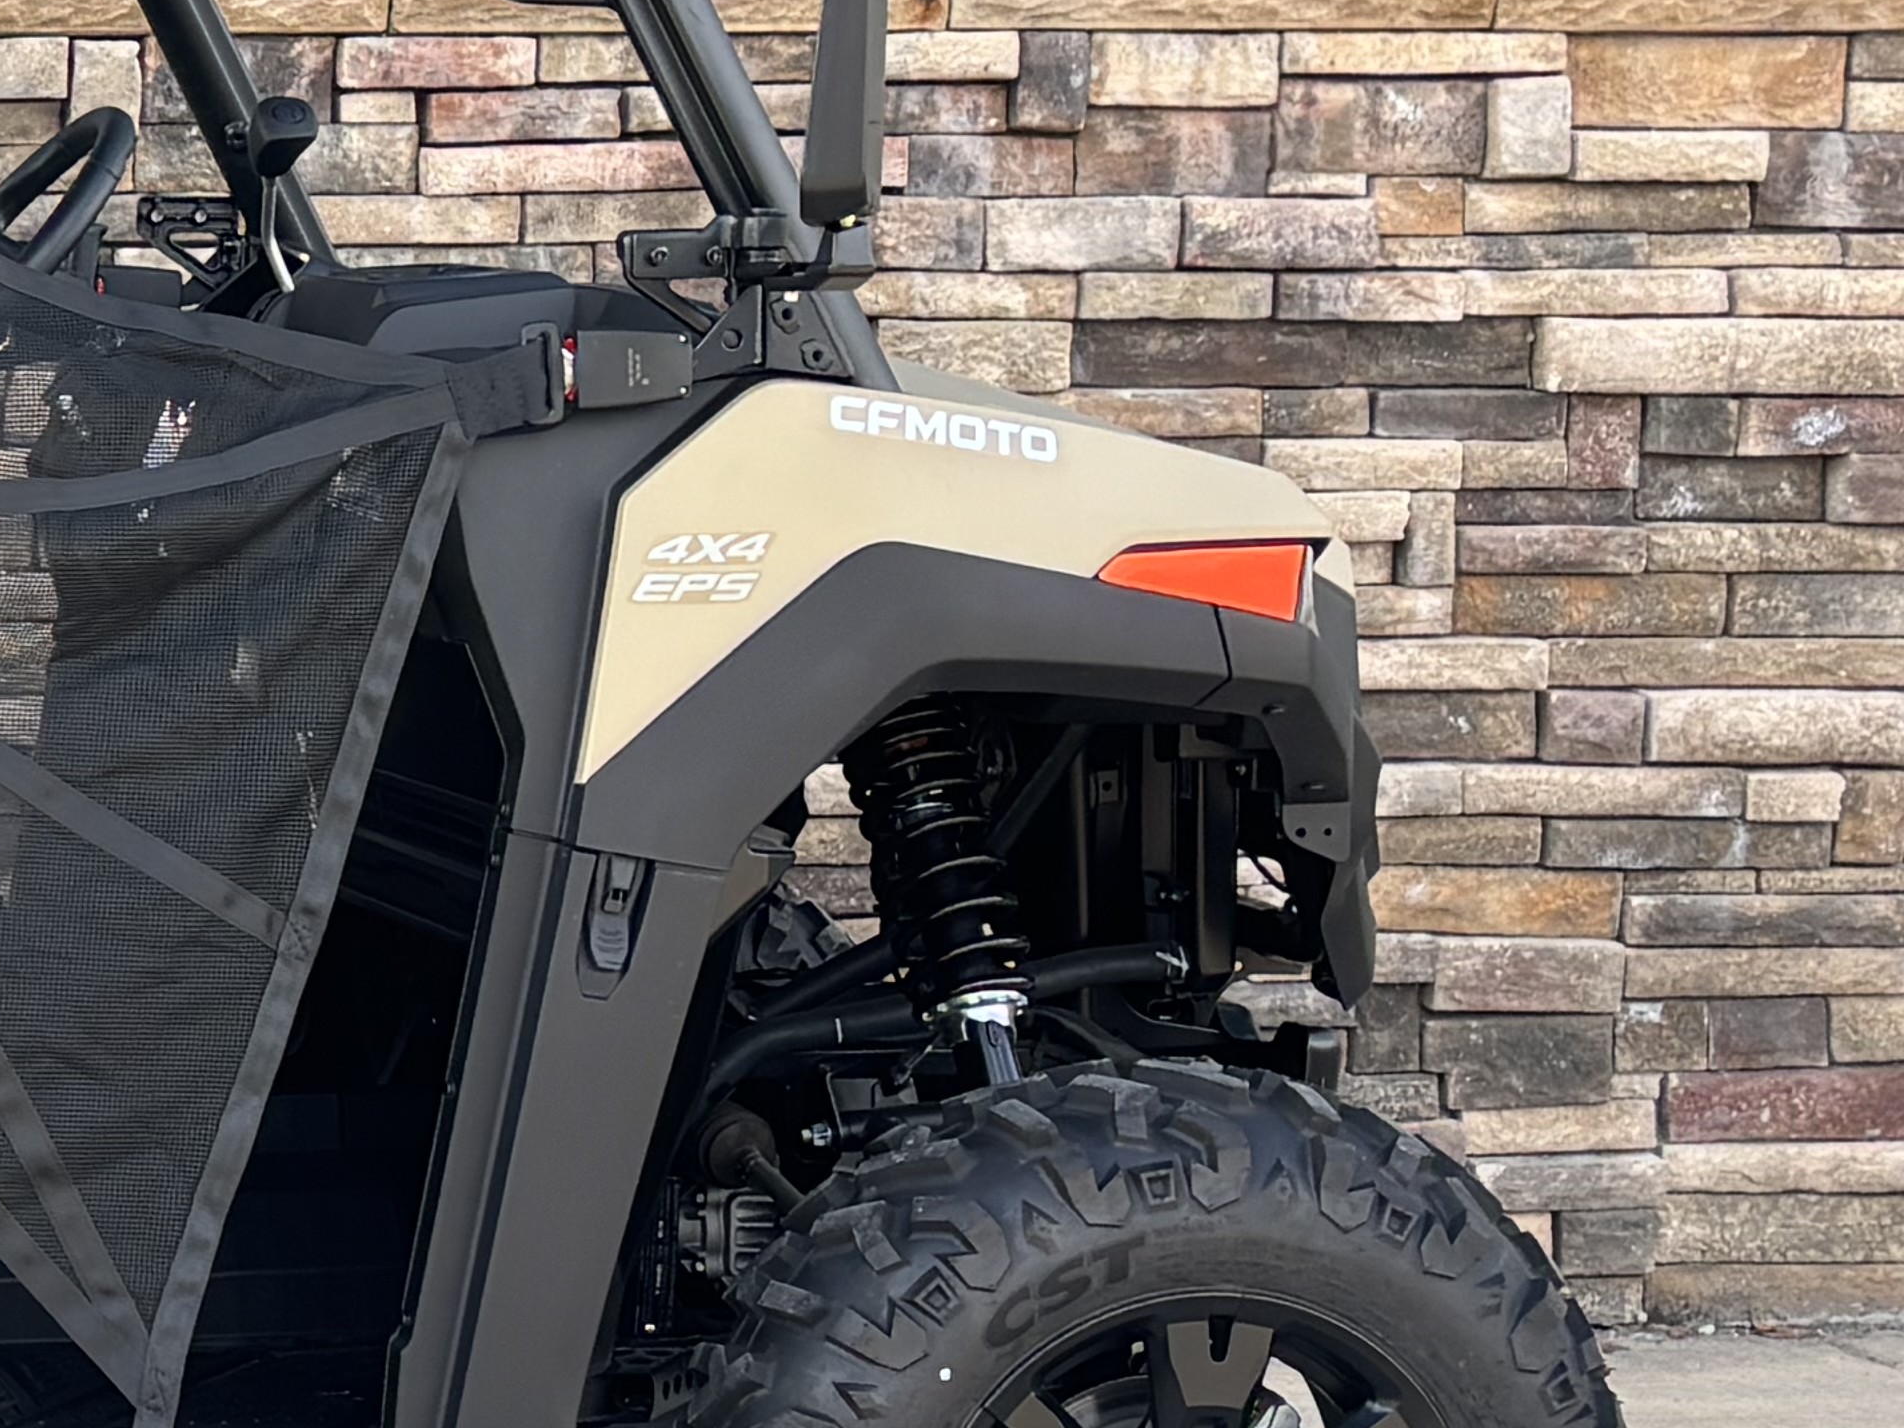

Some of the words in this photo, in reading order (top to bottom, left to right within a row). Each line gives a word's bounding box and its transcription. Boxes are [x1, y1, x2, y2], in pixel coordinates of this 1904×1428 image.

[829, 396, 1059, 464] CFMOTO
[647, 532, 772, 566] 4X4
[631, 571, 761, 604] EPS
[984, 1235, 1146, 1349] CST
